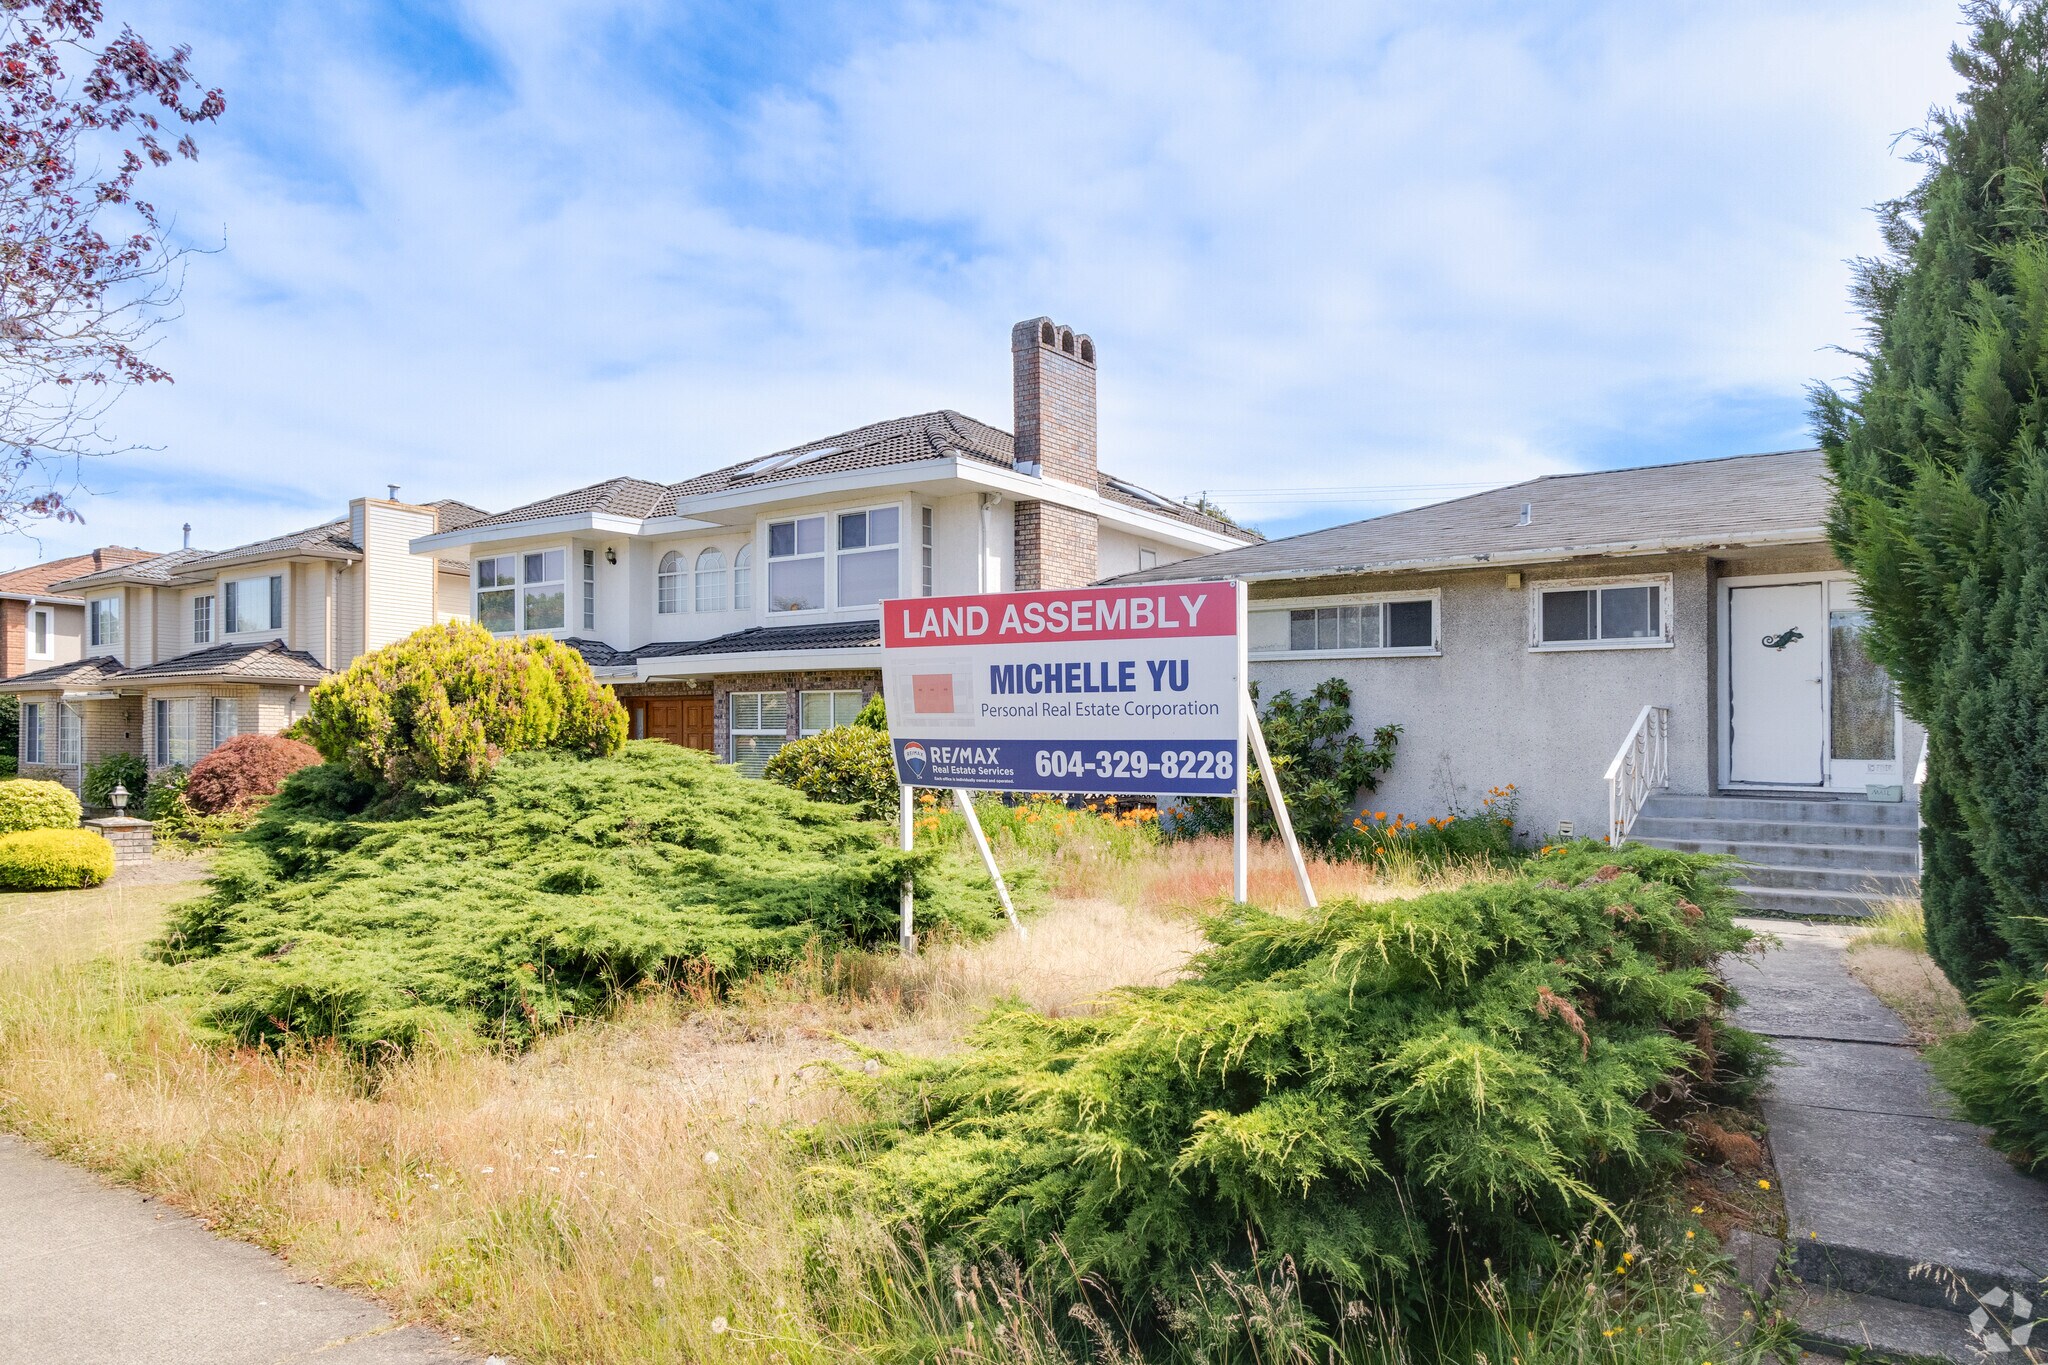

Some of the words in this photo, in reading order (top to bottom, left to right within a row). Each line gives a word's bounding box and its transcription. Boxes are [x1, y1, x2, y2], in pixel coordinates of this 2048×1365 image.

[903, 605, 989, 639] LAND
[999, 594, 1207, 635] ASSEMBLY
[990, 661, 1136, 695] MICHELLE
[1146, 659, 1189, 692] YU
[981, 702, 1038, 717] Personal
[1042, 702, 1071, 716] Real
[1075, 702, 1120, 717] Estate
[1124, 700, 1219, 719] Corporation
[930, 746, 999, 765] RE/MAX
[1035, 750, 1234, 780] 604-329-8228
[932, 765, 949, 774] Real
[951, 766, 976, 775] Estate
[978, 766, 1014, 776] Services
